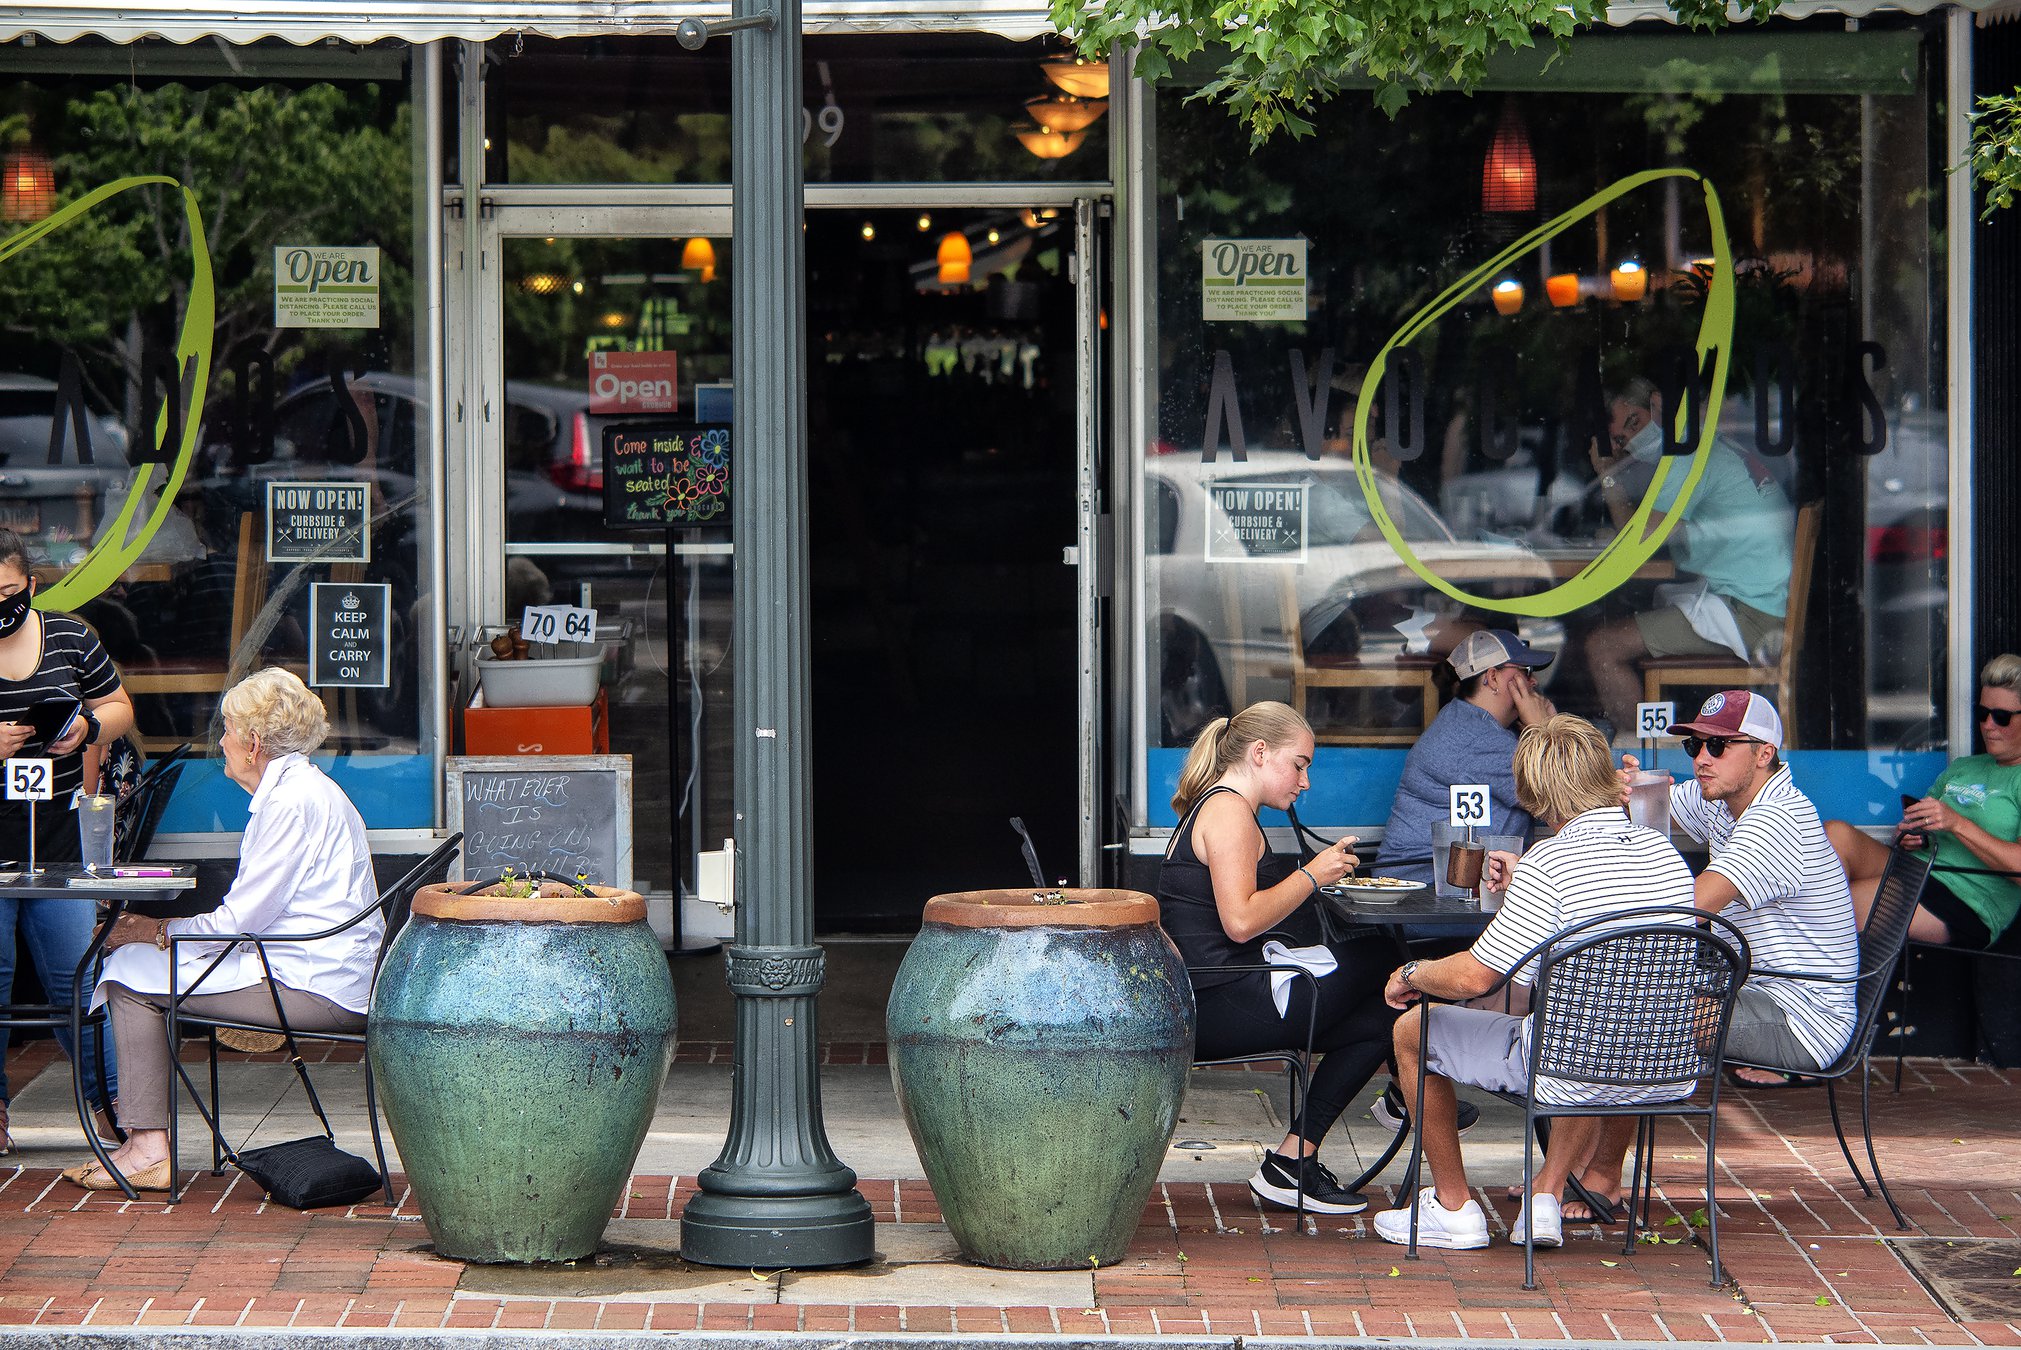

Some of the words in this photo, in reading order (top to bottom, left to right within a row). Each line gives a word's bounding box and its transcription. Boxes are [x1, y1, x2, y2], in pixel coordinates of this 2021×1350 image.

[285, 249, 373, 293] Open
[1211, 242, 1300, 286] Open
[595, 373, 672, 404] Open
[1202, 341, 1887, 463] AVOCADOS
[614, 434, 647, 455] Come
[653, 434, 684, 453] inside
[614, 458, 643, 475] wait
[651, 457, 664, 474] to
[673, 457, 690, 474] be
[626, 473, 670, 493] seated
[277, 490, 311, 510] NOW
[317, 490, 362, 510] OPEN!
[1215, 490, 1249, 510] NOW
[1254, 491, 1300, 511] OPEN!
[291, 515, 336, 527] CURBSIDE
[338, 515, 345, 527] &
[1229, 515, 1273, 527] CURBSIDE
[1276, 516, 1283, 528] &
[296, 528, 339, 540] DELIVERY
[1234, 528, 1277, 540] DELIVERY
[335, 612, 367, 623] KEEP
[531, 612, 556, 637] 70
[565, 612, 591, 637] 64
[331, 628, 370, 639] CALM
[329, 650, 371, 661] CARRY
[340, 667, 360, 678] ON
[1642, 708, 1667, 731] 55
[14, 765, 46, 792] 52
[467, 775, 571, 801] WHATEVER
[1457, 791, 1484, 819] 53
[502, 806, 542, 825] IS
